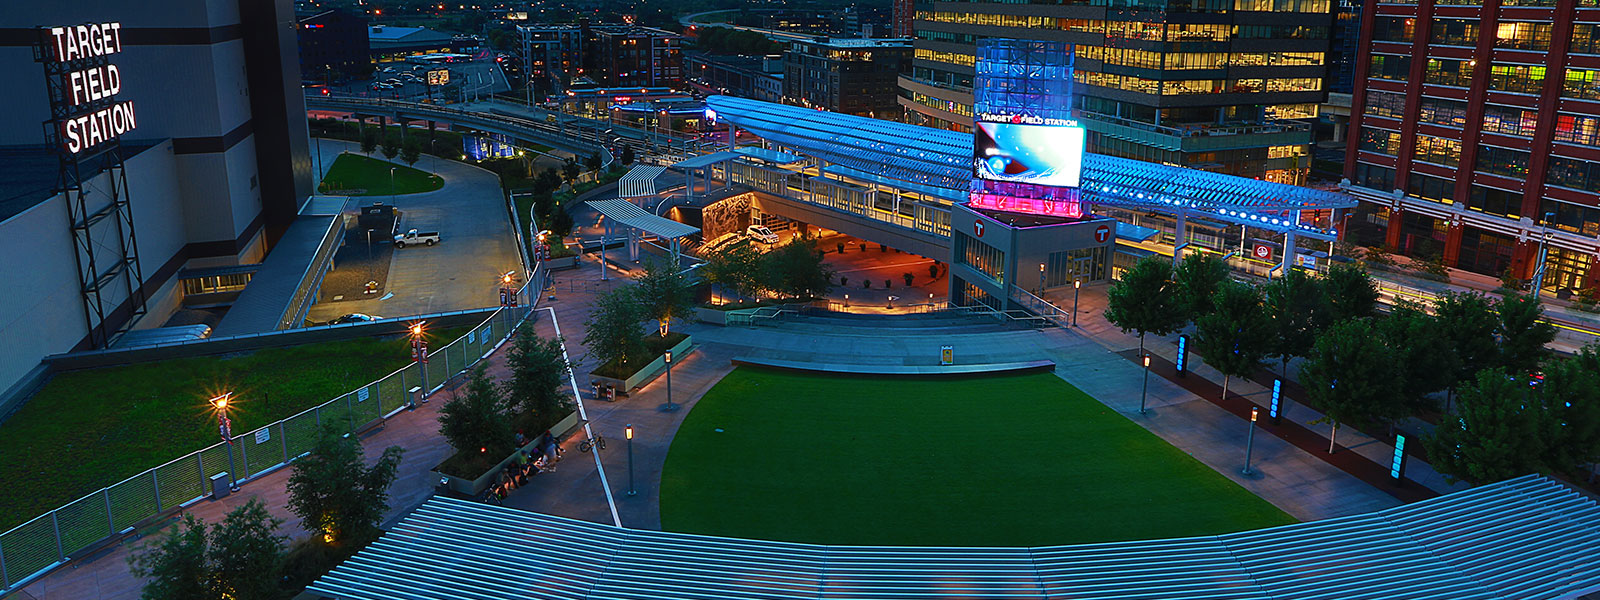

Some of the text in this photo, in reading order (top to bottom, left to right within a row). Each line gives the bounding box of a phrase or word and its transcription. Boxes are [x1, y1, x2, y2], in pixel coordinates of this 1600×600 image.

[52, 22, 121, 62] TARGET
[70, 64, 120, 106] FIELD
[66, 101, 136, 154] STATION
[981, 113, 1078, 127] TARGET FIELD STATION
[975, 222, 983, 235] T
[1096, 229, 1109, 241] T
